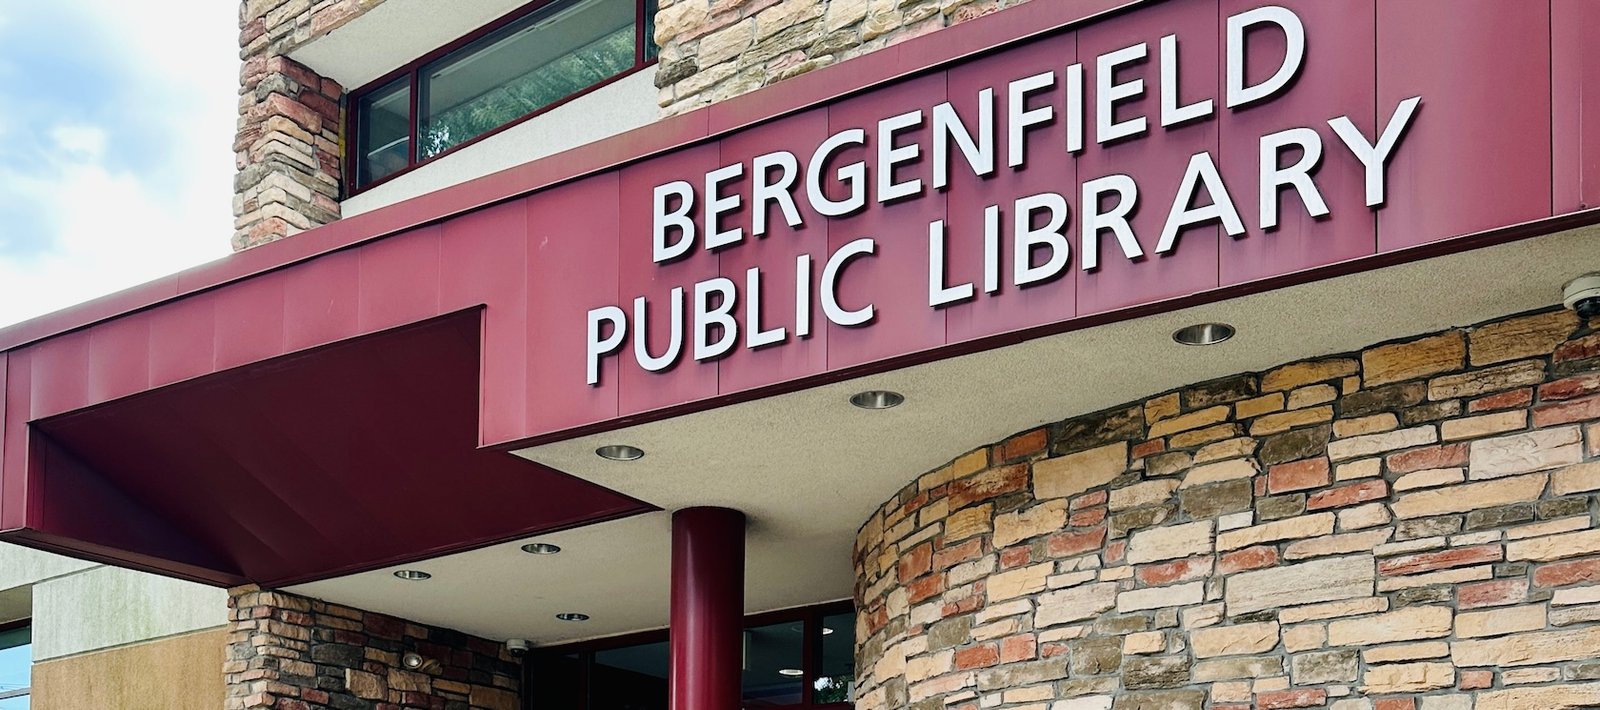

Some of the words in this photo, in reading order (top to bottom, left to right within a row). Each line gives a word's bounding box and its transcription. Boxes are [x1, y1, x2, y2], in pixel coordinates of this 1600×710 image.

[586, 238, 875, 386] PUBLIC
[928, 96, 1421, 307] LIBRARY
[652, 5, 1306, 263] BERGENFIELD
